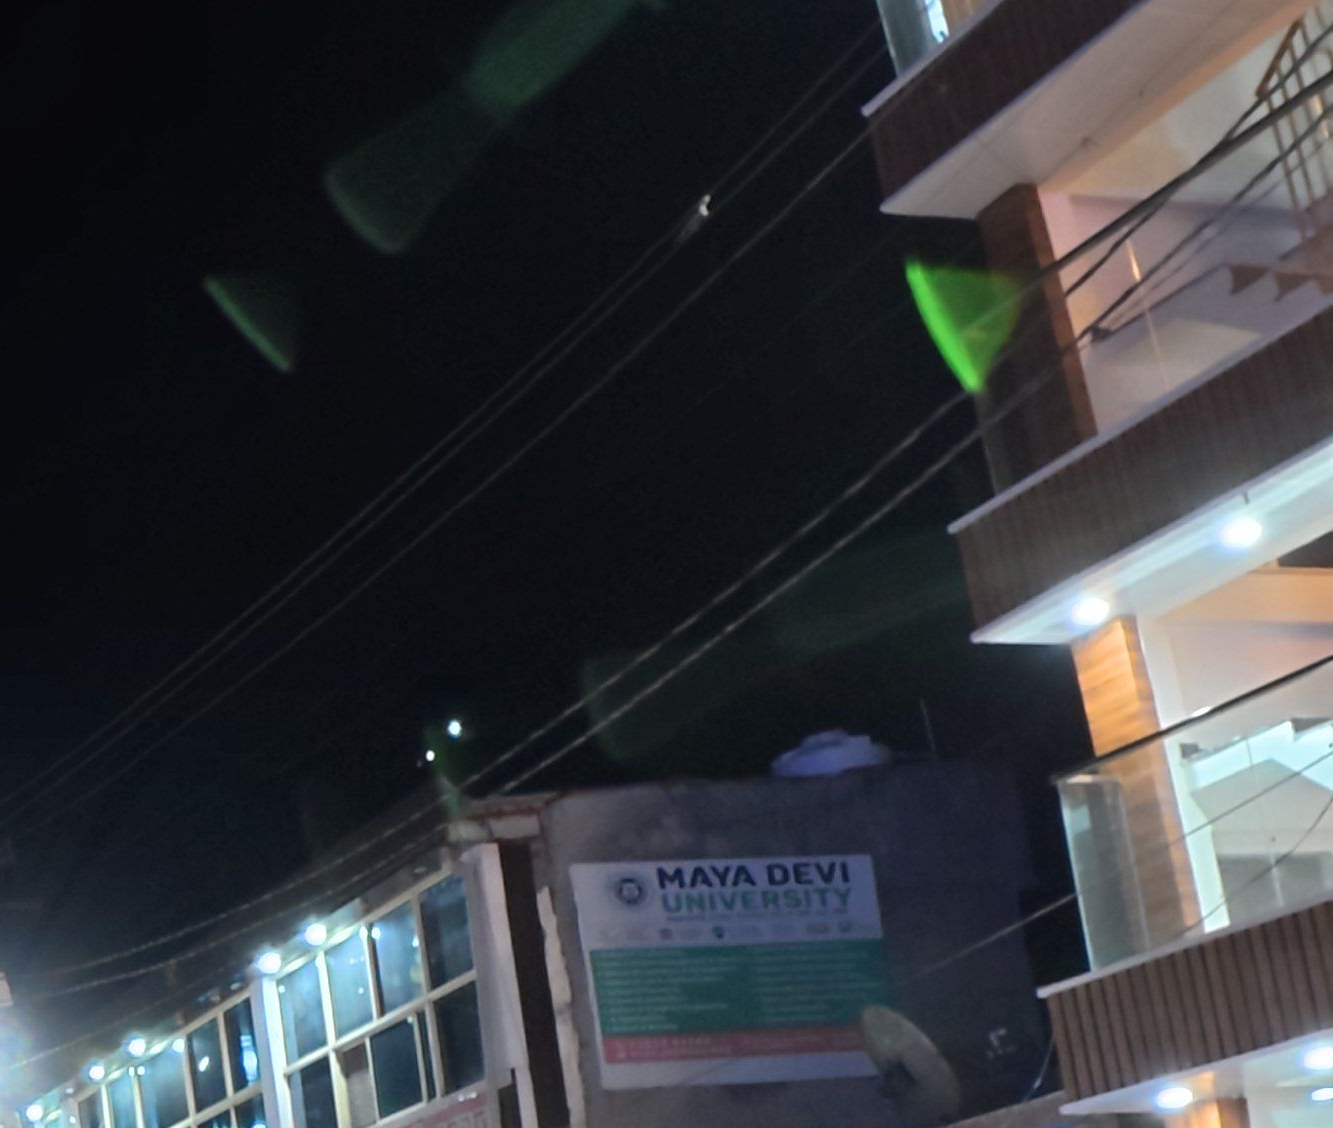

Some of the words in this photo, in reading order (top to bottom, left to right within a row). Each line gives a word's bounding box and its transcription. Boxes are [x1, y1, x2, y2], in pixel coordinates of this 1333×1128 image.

[656, 864, 757, 890] MAYA
[766, 861, 851, 886] DEVI
[661, 887, 852, 914] UNIVERSITY
